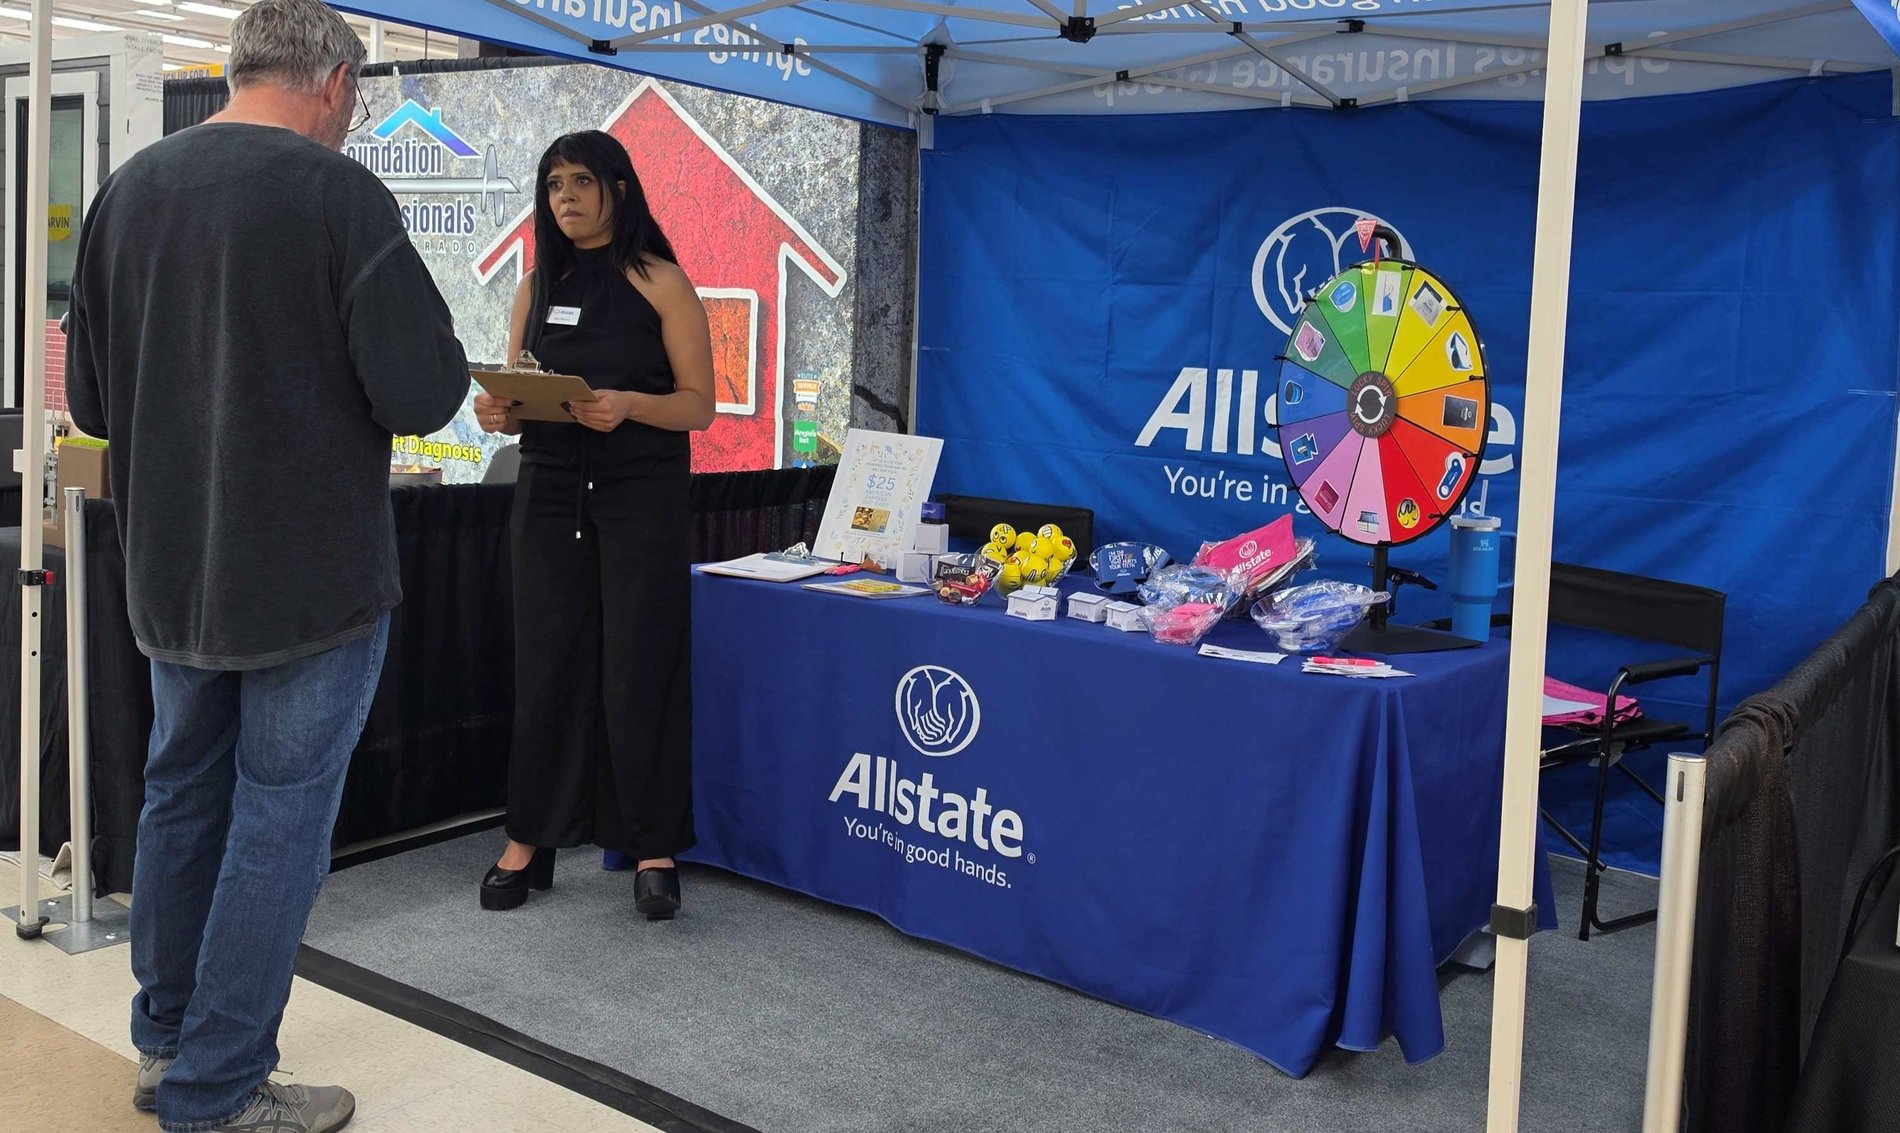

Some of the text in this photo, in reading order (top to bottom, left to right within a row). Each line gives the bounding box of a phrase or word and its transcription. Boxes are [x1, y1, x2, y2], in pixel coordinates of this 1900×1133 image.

[343, 140, 442, 174] oundation
[48, 216, 70, 229] RVIN
[401, 200, 475, 235] sionals
[411, 240, 477, 253] ORADO
[1352, 374, 1374, 396] LUCKY
[408, 434, 482, 464] Diagnosis
[866, 473, 896, 491] $25
[1163, 465, 1254, 500] You're
[1262, 474, 1289, 505] in
[828, 752, 1024, 858] Allstate
[844, 816, 1012, 889] You're in good hands.
